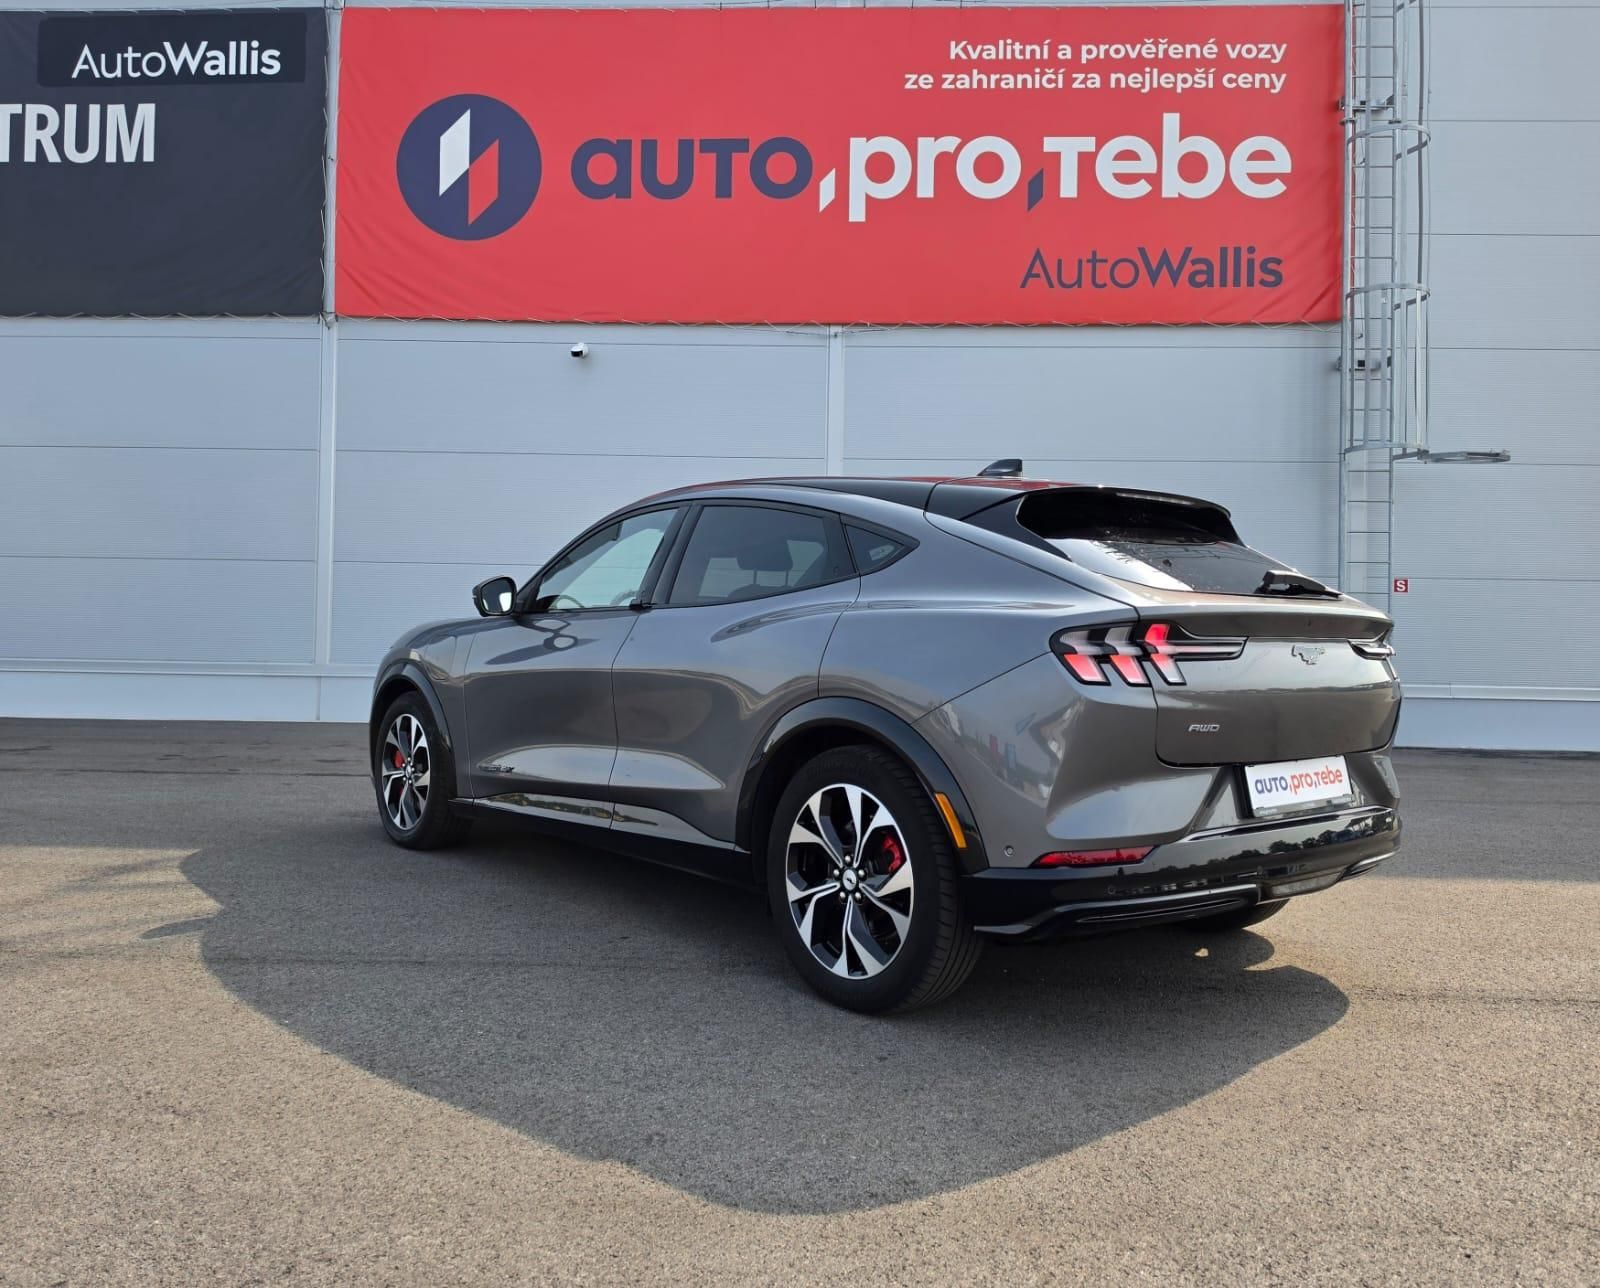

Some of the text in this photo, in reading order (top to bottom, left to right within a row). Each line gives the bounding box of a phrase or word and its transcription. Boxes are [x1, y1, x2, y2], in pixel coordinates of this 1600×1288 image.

[71, 40, 281, 79] AutoWallis
[949, 38, 1287, 64] Kvalitní a prověřené vozy
[904, 67, 1287, 94] ze zahraničí za nejlepší ceny
[1019, 246, 1284, 289] AutoWallis
[1396, 580, 1406, 592] S
[1188, 724, 1221, 732] AWD
